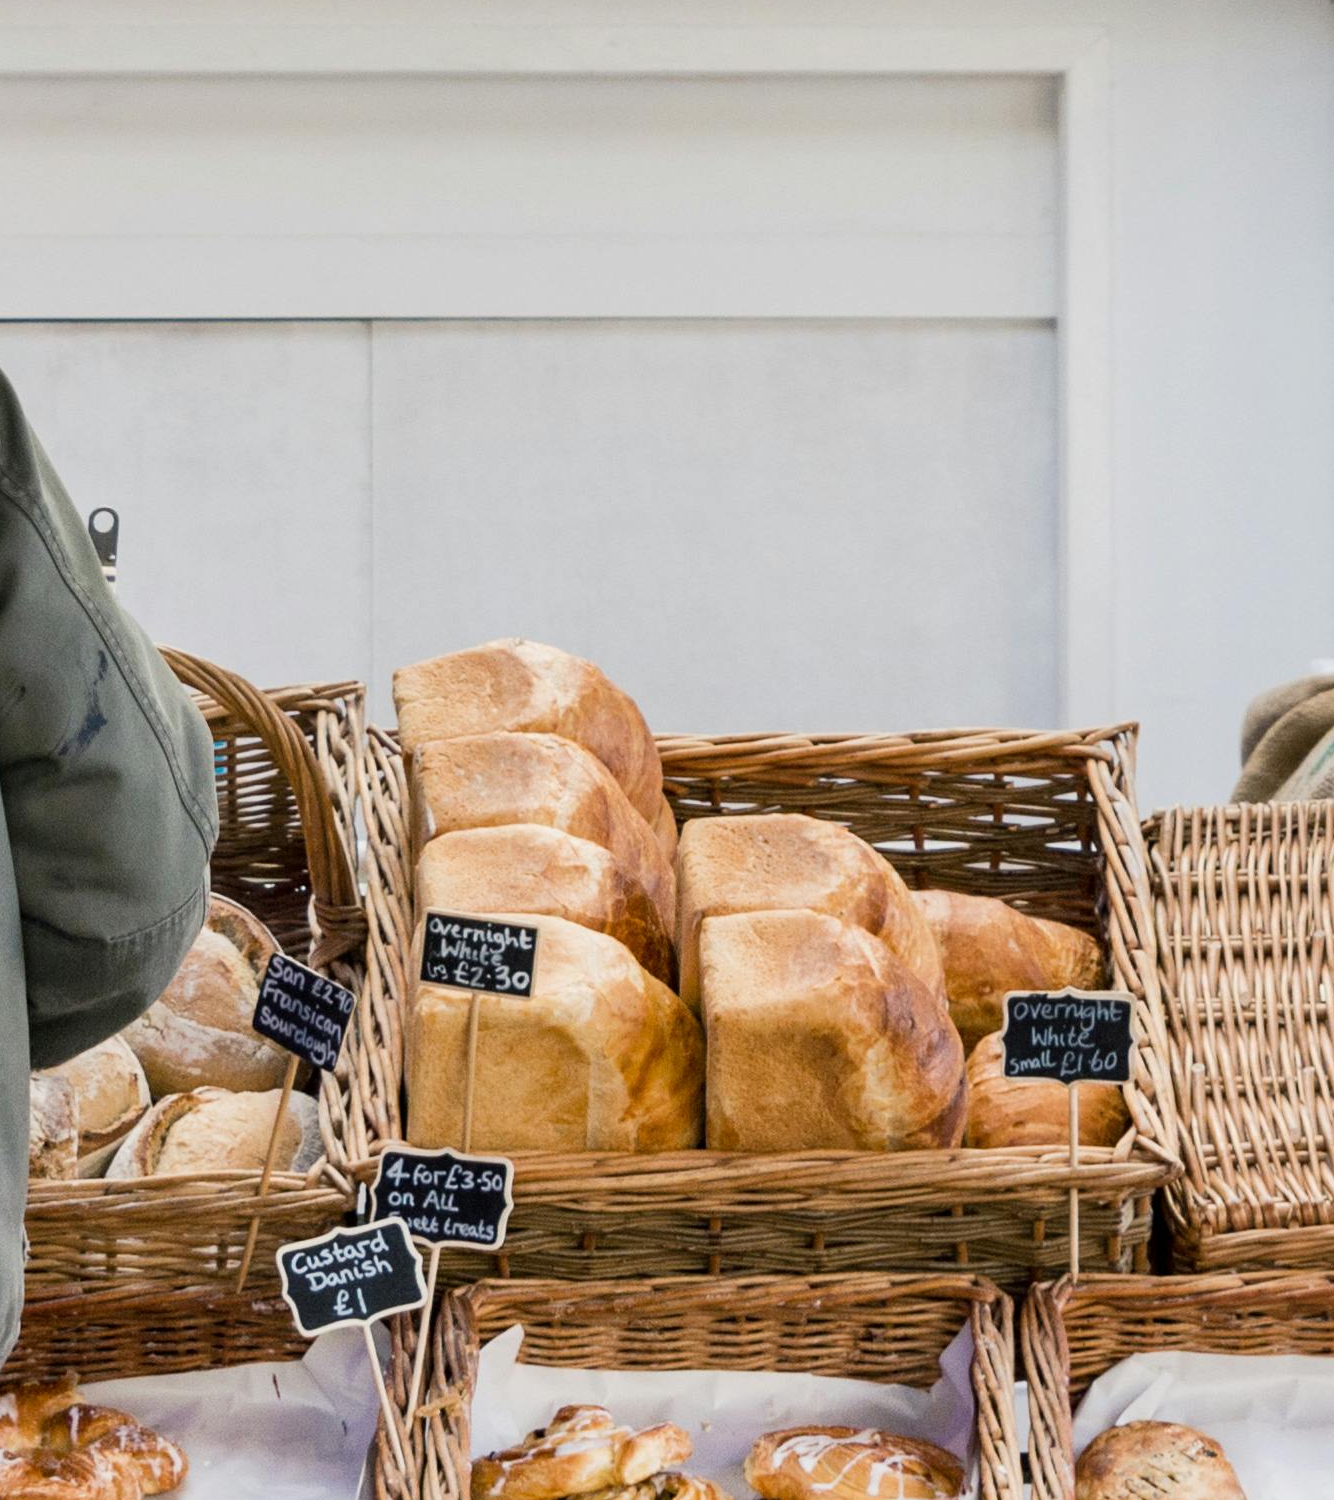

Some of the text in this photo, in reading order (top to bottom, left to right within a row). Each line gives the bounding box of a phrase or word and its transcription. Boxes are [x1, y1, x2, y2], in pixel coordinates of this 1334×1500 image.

[429, 917, 533, 953] Overnight
[440, 937, 504, 966] White
[268, 956, 306, 991] San
[1030, 1024, 1096, 1048] White
[385, 1157, 411, 1188] 4
[413, 1163, 447, 1186] for
[387, 1191, 415, 1207] on
[443, 1217, 495, 1242] treats
[290, 1228, 390, 1275] Custard
[305, 1254, 394, 1292] Danish
[332, 1287, 368, 1317] £1
